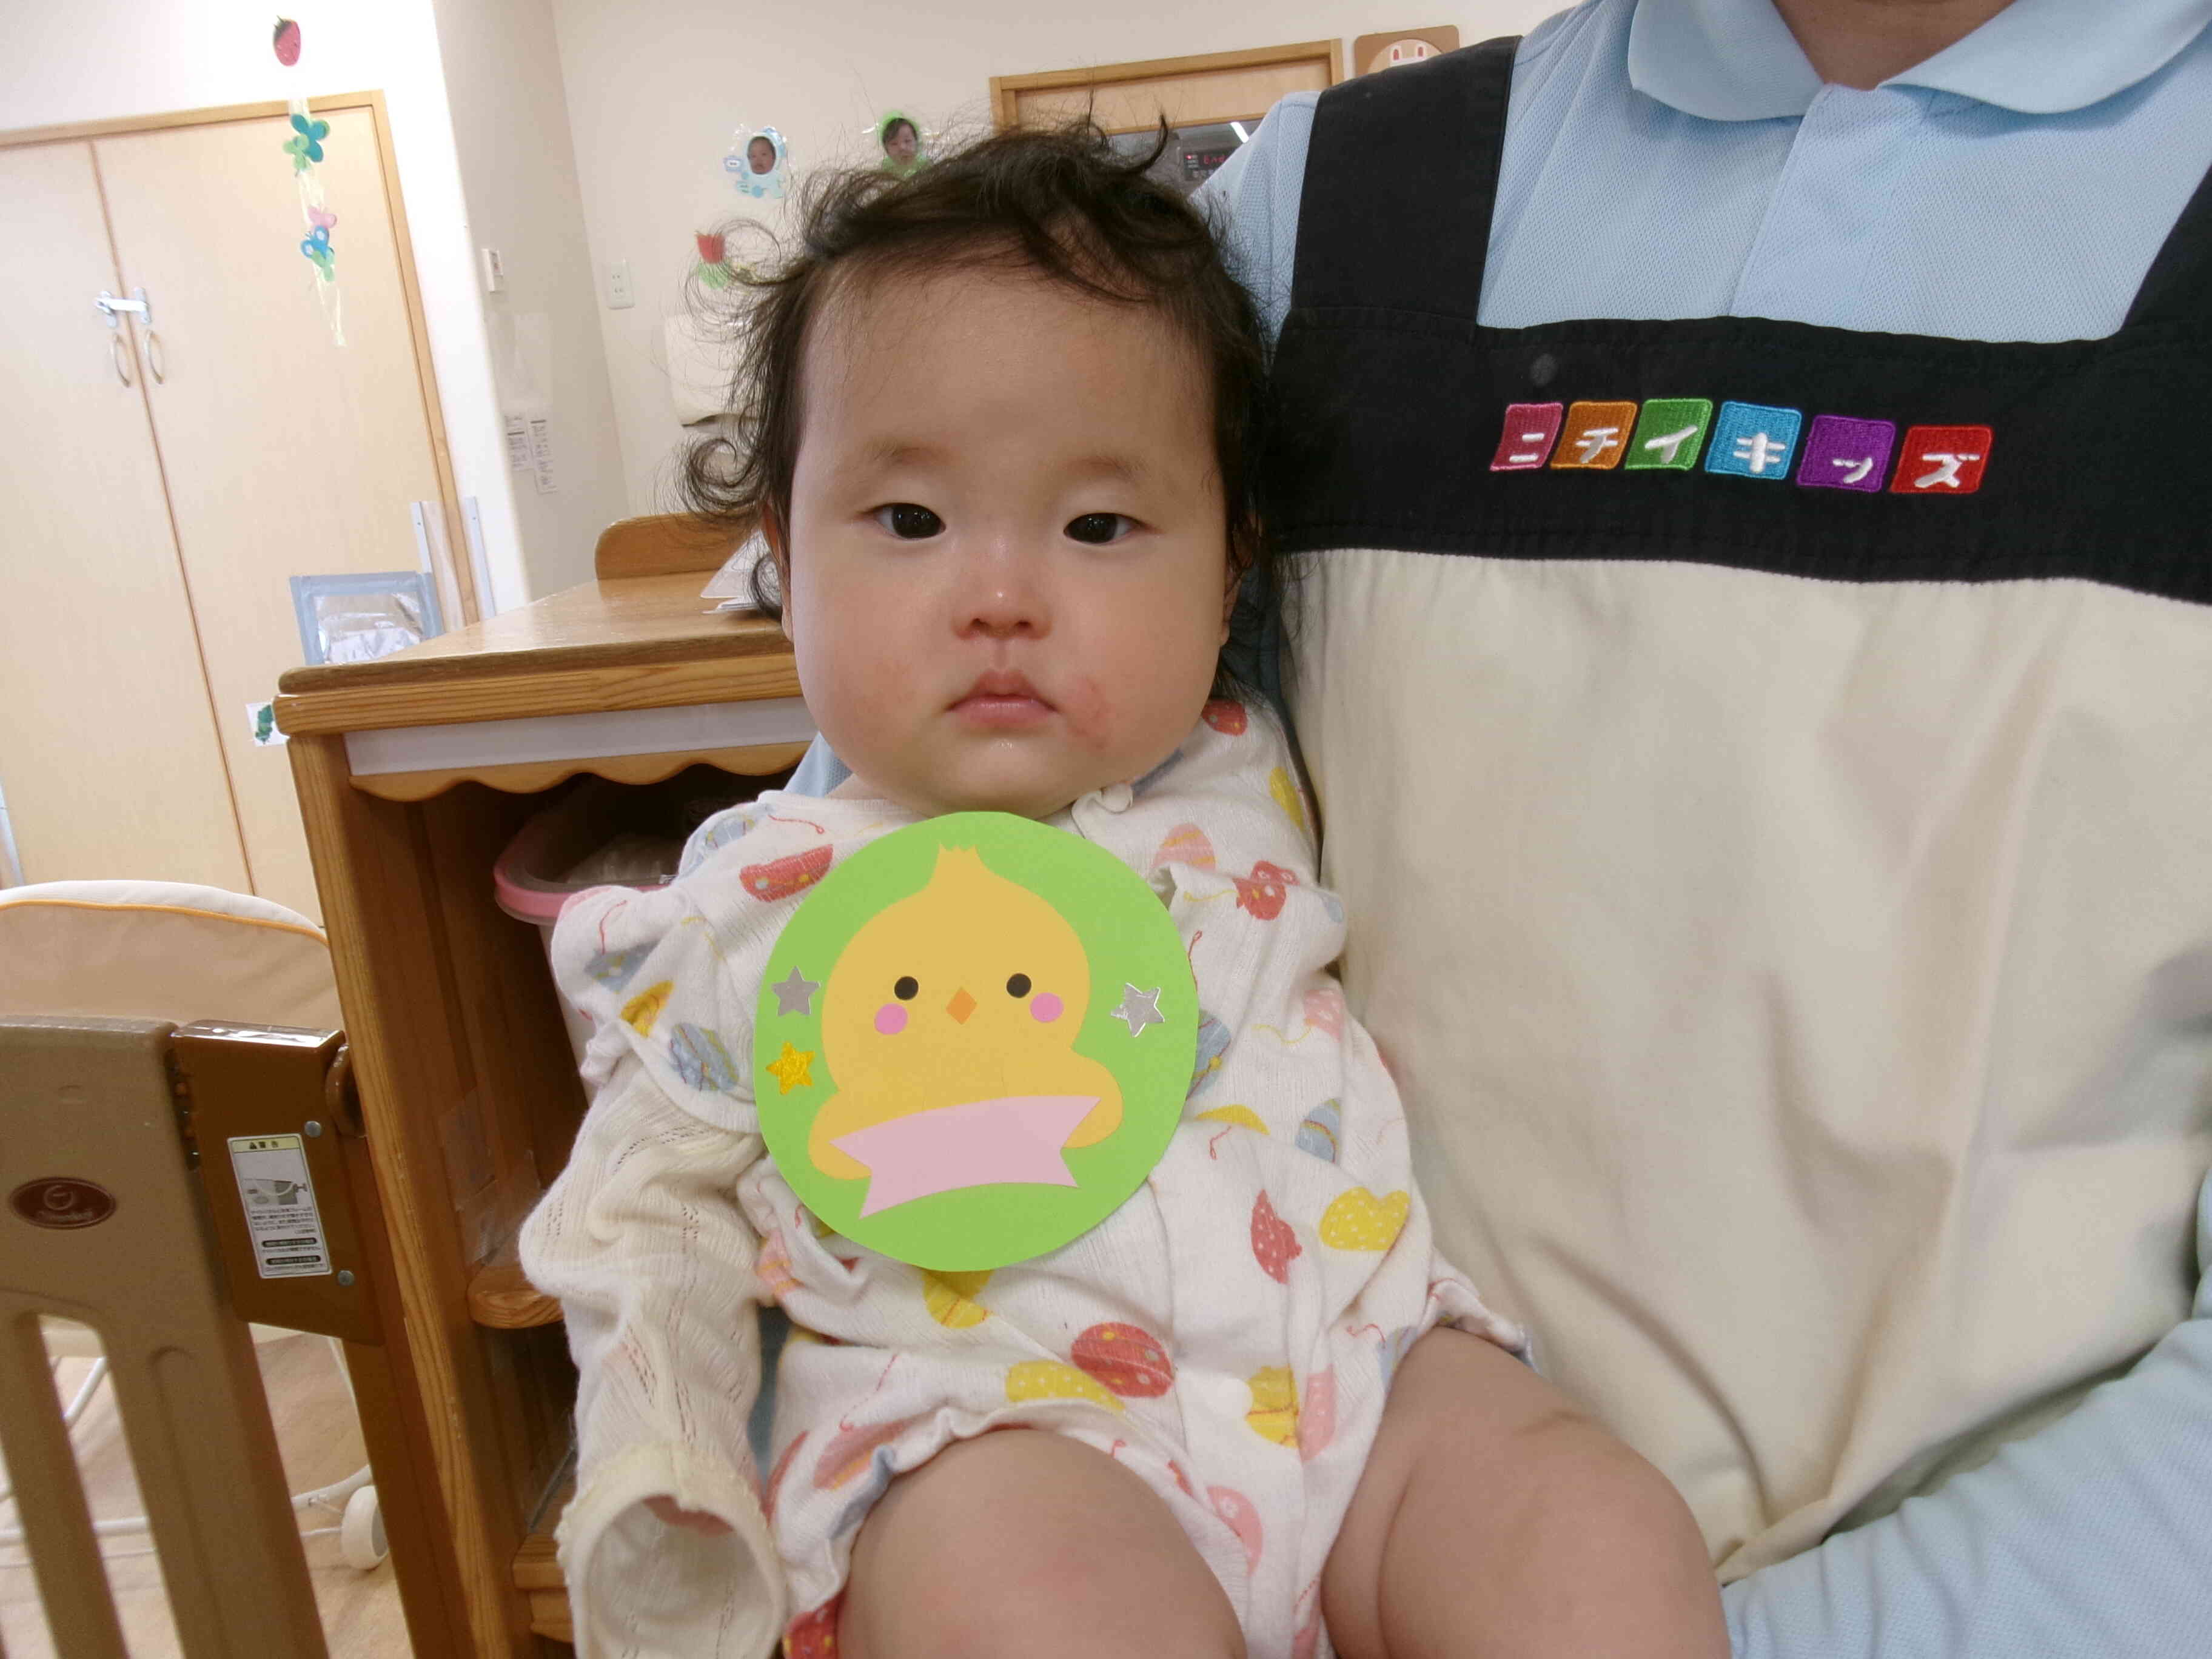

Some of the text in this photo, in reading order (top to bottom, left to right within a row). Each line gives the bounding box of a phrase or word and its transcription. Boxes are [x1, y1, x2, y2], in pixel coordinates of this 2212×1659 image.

[1509, 425, 1982, 489] ニチイキッズ
